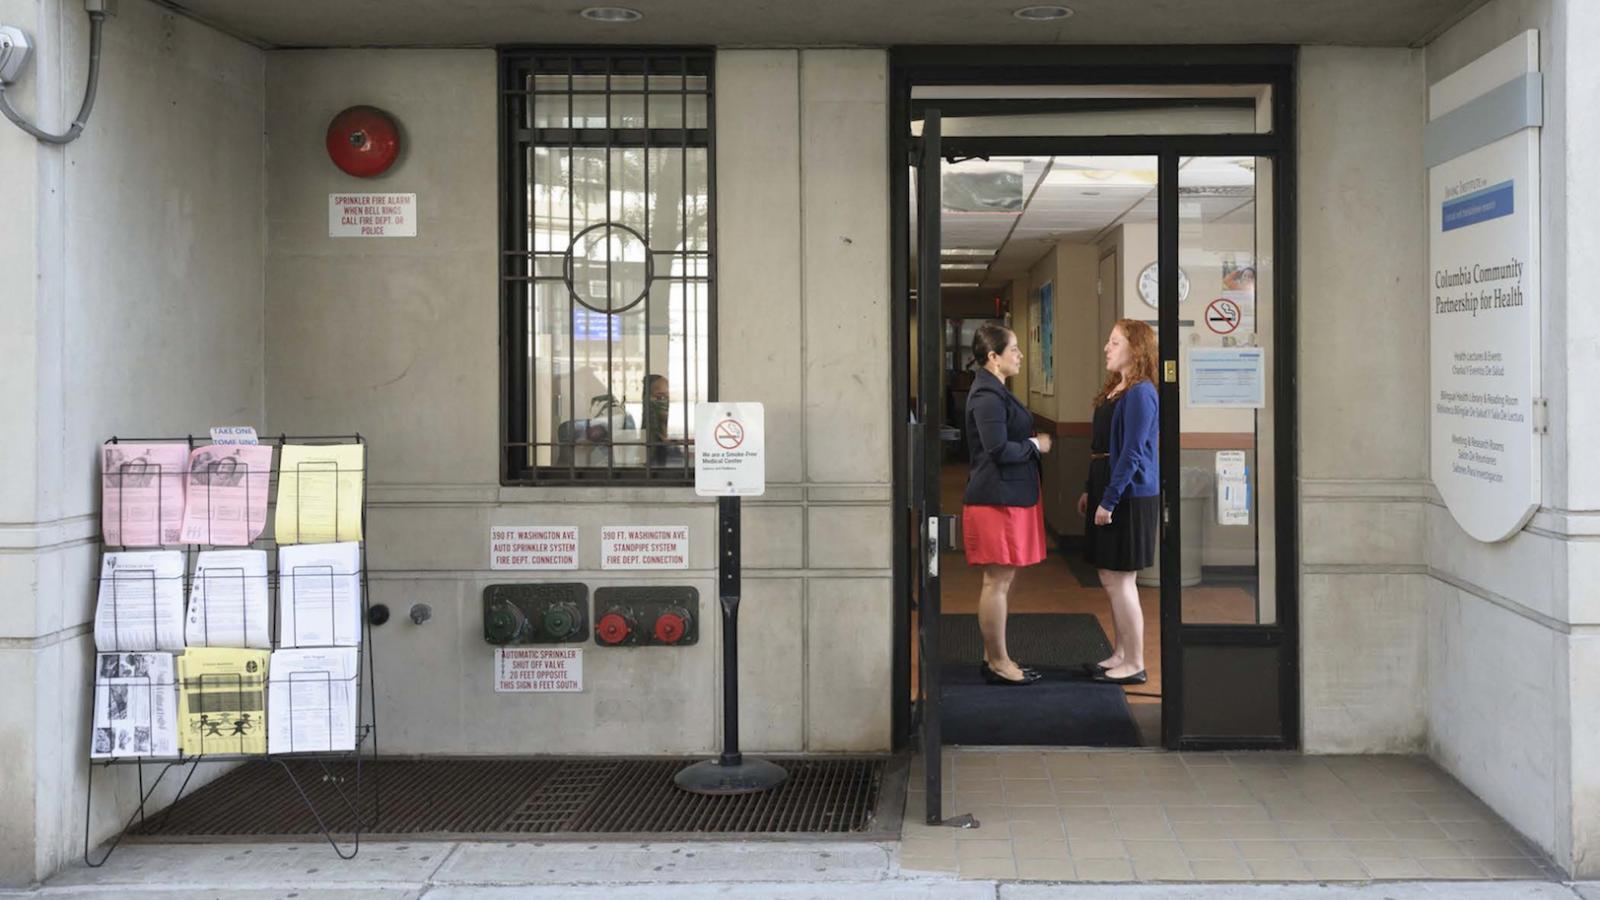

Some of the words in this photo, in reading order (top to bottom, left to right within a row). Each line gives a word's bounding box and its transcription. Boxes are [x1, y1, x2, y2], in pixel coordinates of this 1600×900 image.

[334, 196, 370, 205] SPRINKLER
[372, 196, 386, 205] FIRE
[388, 196, 411, 205] ALARM
[344, 207, 363, 215] WHEN
[364, 207, 380, 215] BELL
[382, 207, 401, 215] RINGS
[341, 216, 357, 225] CALL
[360, 216, 372, 225] FIRE
[395, 216, 404, 225] OR
[361, 226, 384, 235] POLICE
[1435, 266, 1471, 289] Columbia
[1473, 257, 1524, 284] Community
[1436, 292, 1479, 317] Partnership
[1480, 289, 1491, 310] for
[1494, 285, 1523, 308] Health
[492, 532, 505, 540] 390
[518, 532, 560, 540] WASHINGTON
[603, 532, 616, 540] 390
[618, 532, 627, 540] FT.
[628, 532, 671, 540] WASHINGTON
[494, 544, 510, 552] AUTO
[512, 544, 548, 552] SPRINKLER
[550, 544, 576, 552] SYSTEM
[613, 544, 649, 552] STANDPIPE
[651, 544, 676, 552] SYSTEM
[496, 556, 510, 564] FIRE
[512, 556, 530, 564] DEPT.
[532, 556, 573, 564] CONNECTION
[607, 556, 620, 564] FIRE
[622, 556, 641, 564] DEPT.
[642, 556, 683, 564] CONNECTION
[502, 650, 539, 658] AUTOMATIC
[540, 650, 576, 658] SPRINKLER
[512, 660, 529, 669] SHUT
[530, 660, 542, 669] OFF
[544, 660, 565, 669] VALVE
[510, 670, 518, 679] 20
[520, 670, 534, 679] FEET
[537, 670, 568, 679] OPPOSITE
[500, 681, 514, 689] THIS
[516, 681, 531, 689] SIGN
[539, 681, 554, 689] FEET
[556, 681, 578, 689] SOUTH
